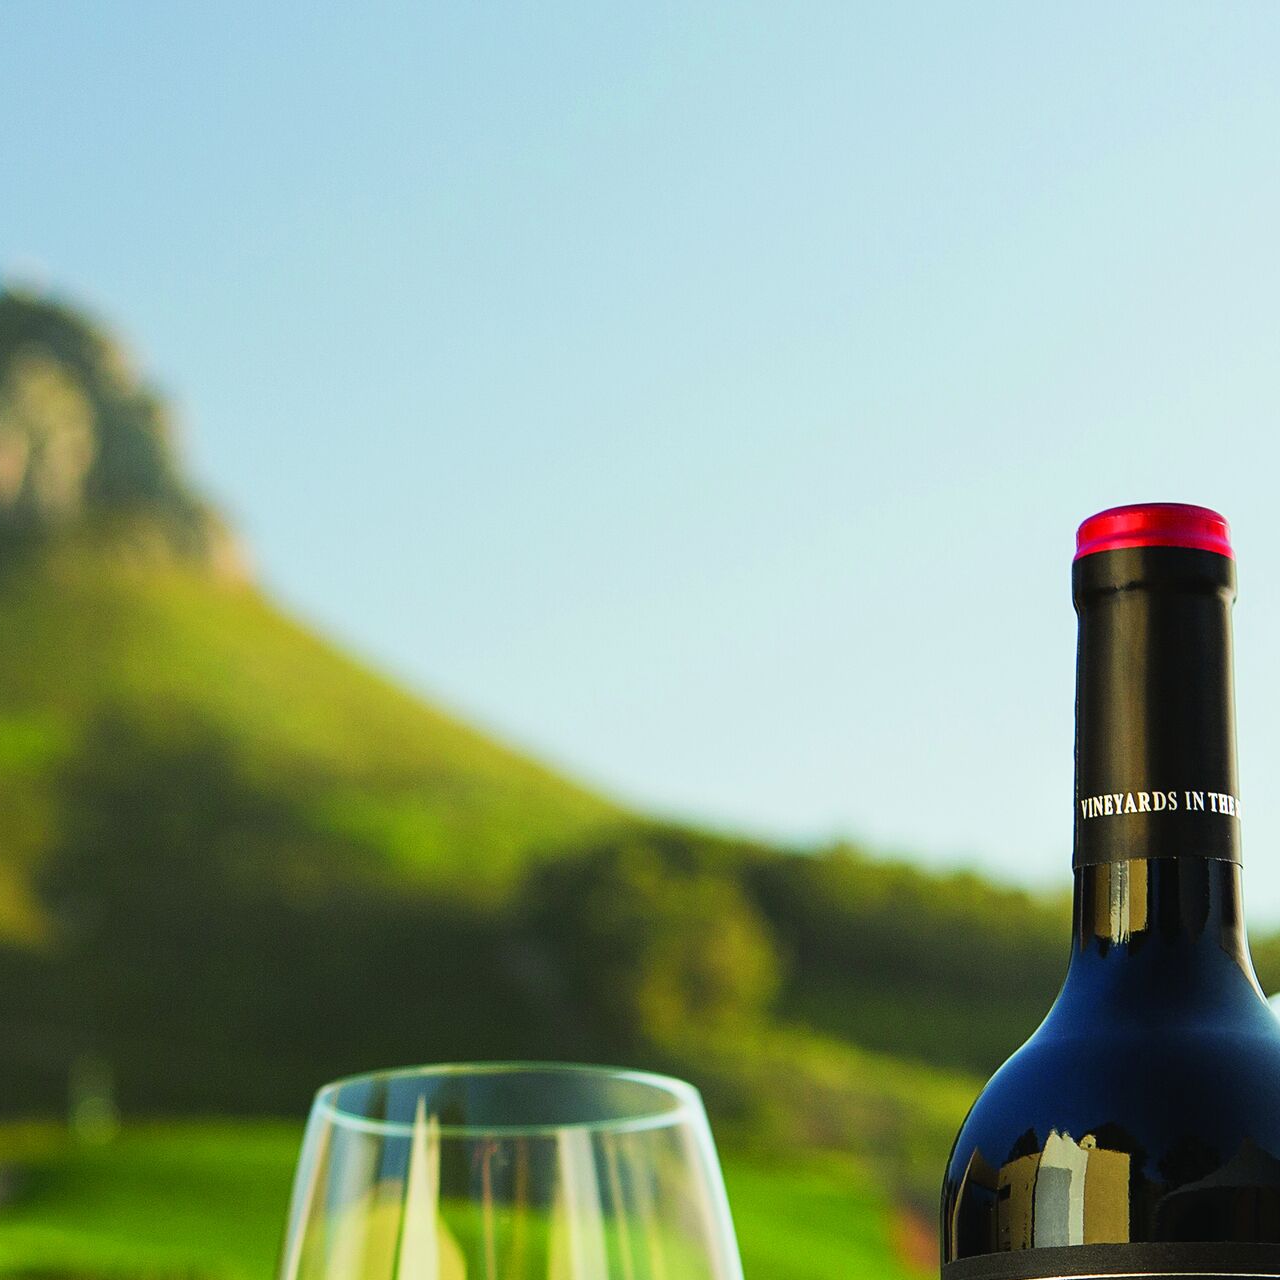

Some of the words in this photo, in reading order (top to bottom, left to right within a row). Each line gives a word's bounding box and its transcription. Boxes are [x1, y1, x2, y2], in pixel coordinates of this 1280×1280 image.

[1081, 791, 1177, 819] VINEYARDS
[1185, 791, 1205, 811] IN
[1208, 792, 1235, 816] THE
